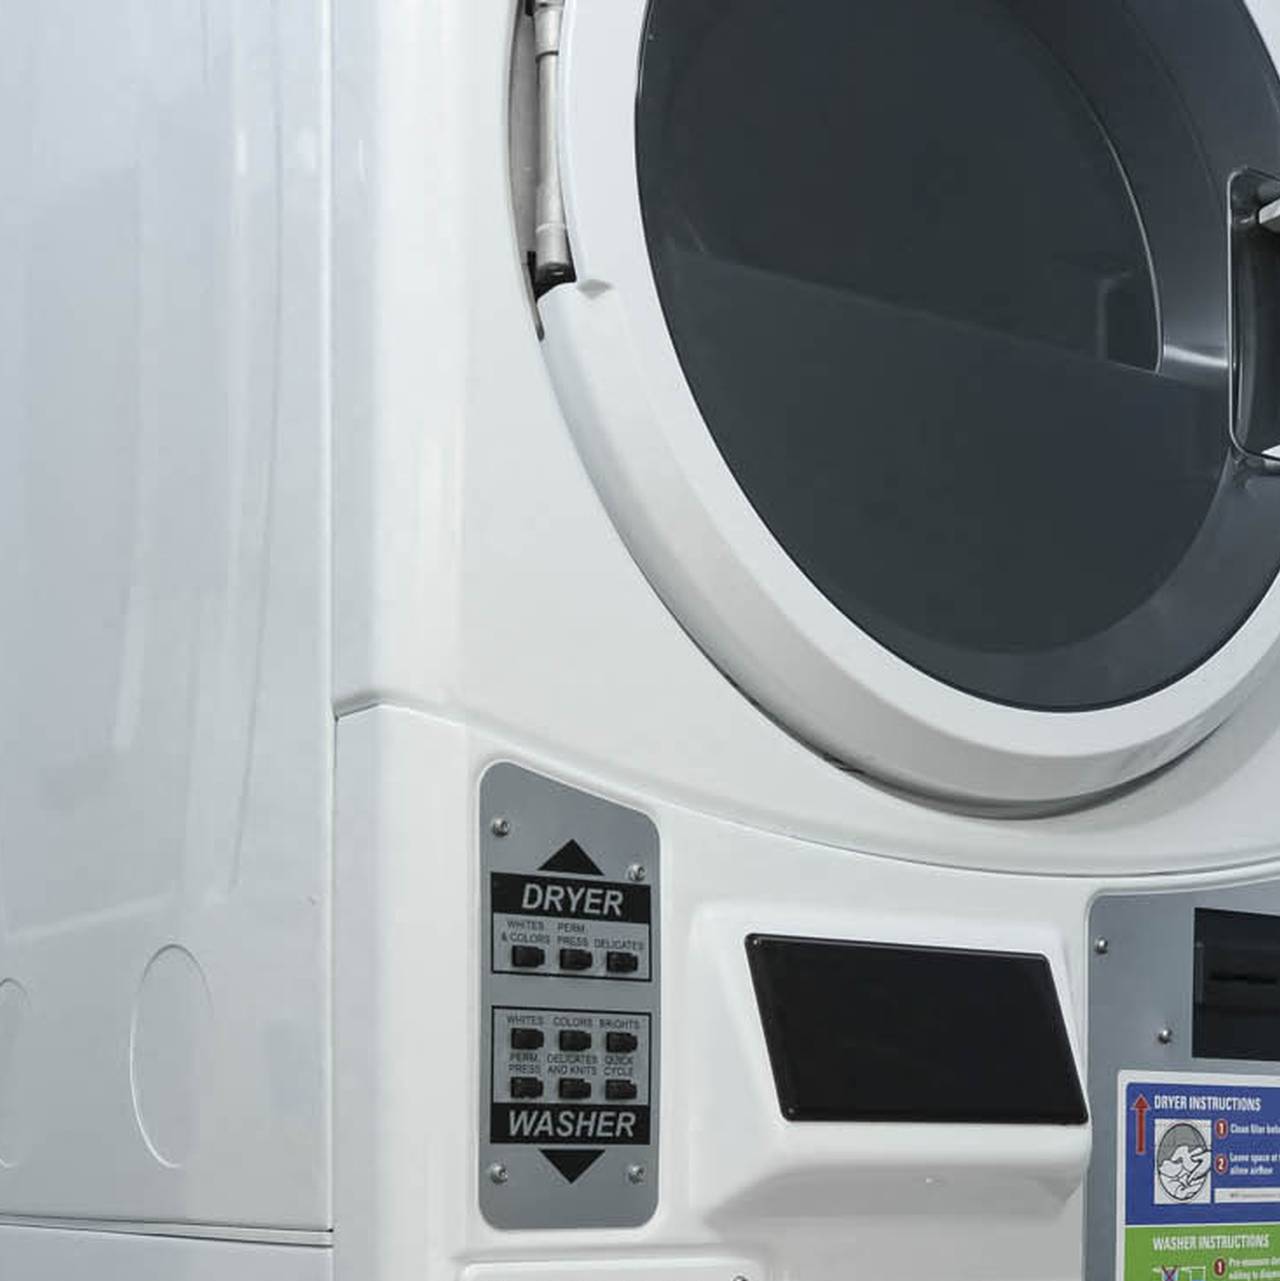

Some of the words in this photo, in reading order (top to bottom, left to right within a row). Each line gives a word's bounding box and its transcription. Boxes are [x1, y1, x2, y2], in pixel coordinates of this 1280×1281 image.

[522, 883, 624, 916] DRYER
[506, 920, 545, 931] WHITES
[510, 933, 550, 945] COLORS
[557, 936, 589, 947] PRESS
[594, 938, 645, 950] DELICATES
[506, 1016, 545, 1026] WHITES
[553, 1016, 593, 1027] COLORS
[599, 1018, 640, 1030] BRIGHTS
[547, 1053, 598, 1064] DELICATES
[605, 1055, 634, 1066] QUICK
[508, 1064, 541, 1075] PRESS
[547, 1065, 568, 1075] AND
[570, 1066, 597, 1076] KNITS
[604, 1066, 634, 1077] CYCLE
[1154, 1095, 1187, 1111] DRYER
[1189, 1096, 1262, 1112] INSTRUCTIONS
[508, 1110, 636, 1137] WASHER
[1153, 1235, 1196, 1250] WASHER
[1199, 1234, 1270, 1250] INSTRUCTIONS
